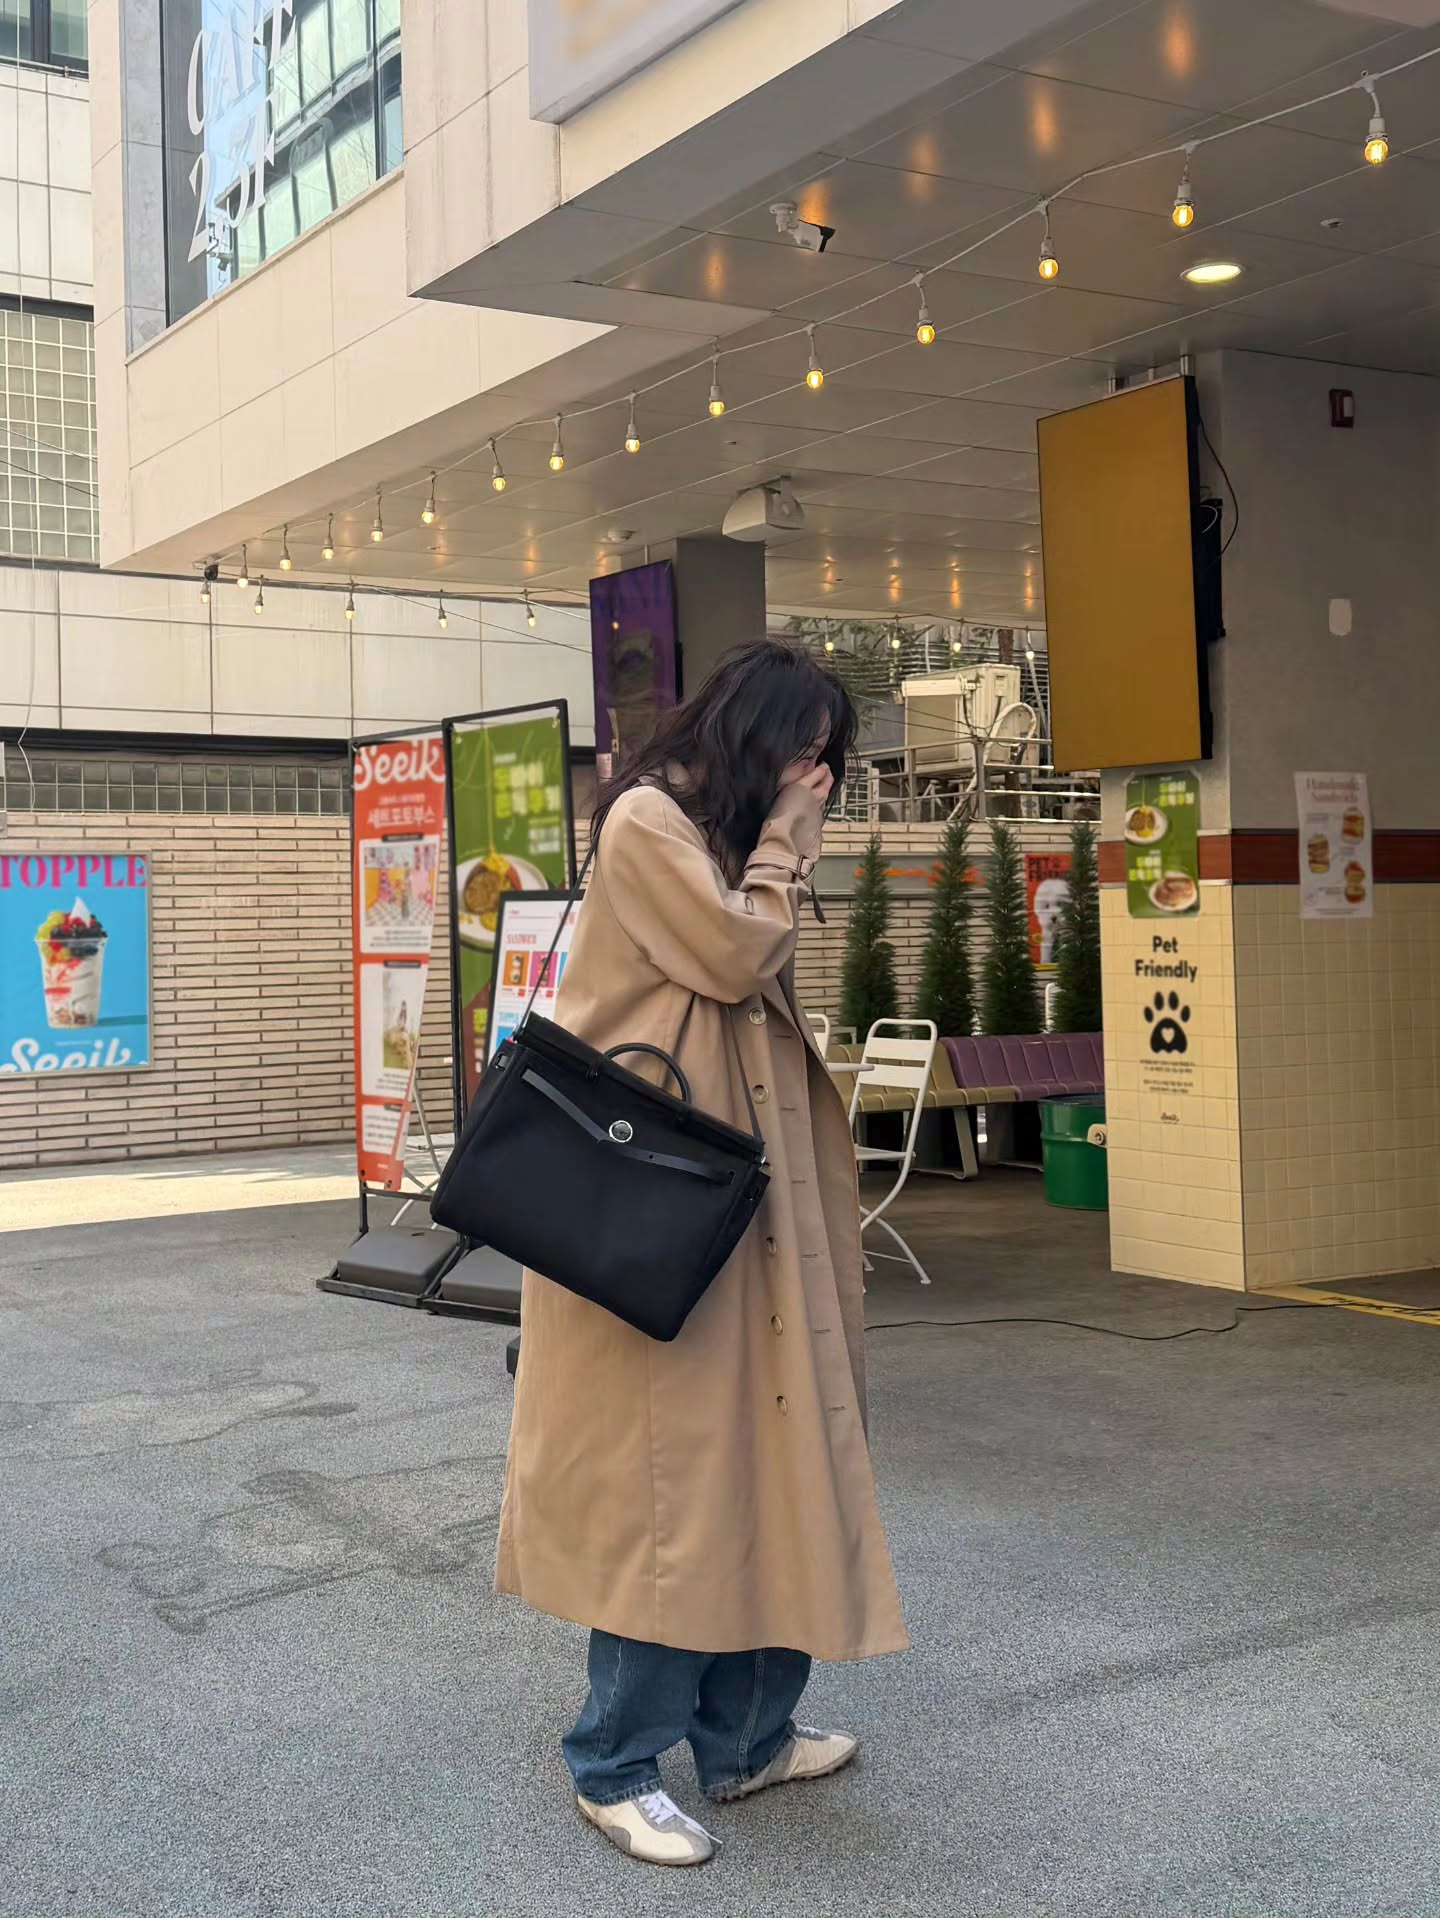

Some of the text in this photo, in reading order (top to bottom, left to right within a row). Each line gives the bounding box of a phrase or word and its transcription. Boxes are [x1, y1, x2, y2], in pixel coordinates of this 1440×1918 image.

[354, 738, 446, 791] Seeik
[1152, 935, 1178, 953] Pet
[1134, 959, 1197, 983] Friendly
